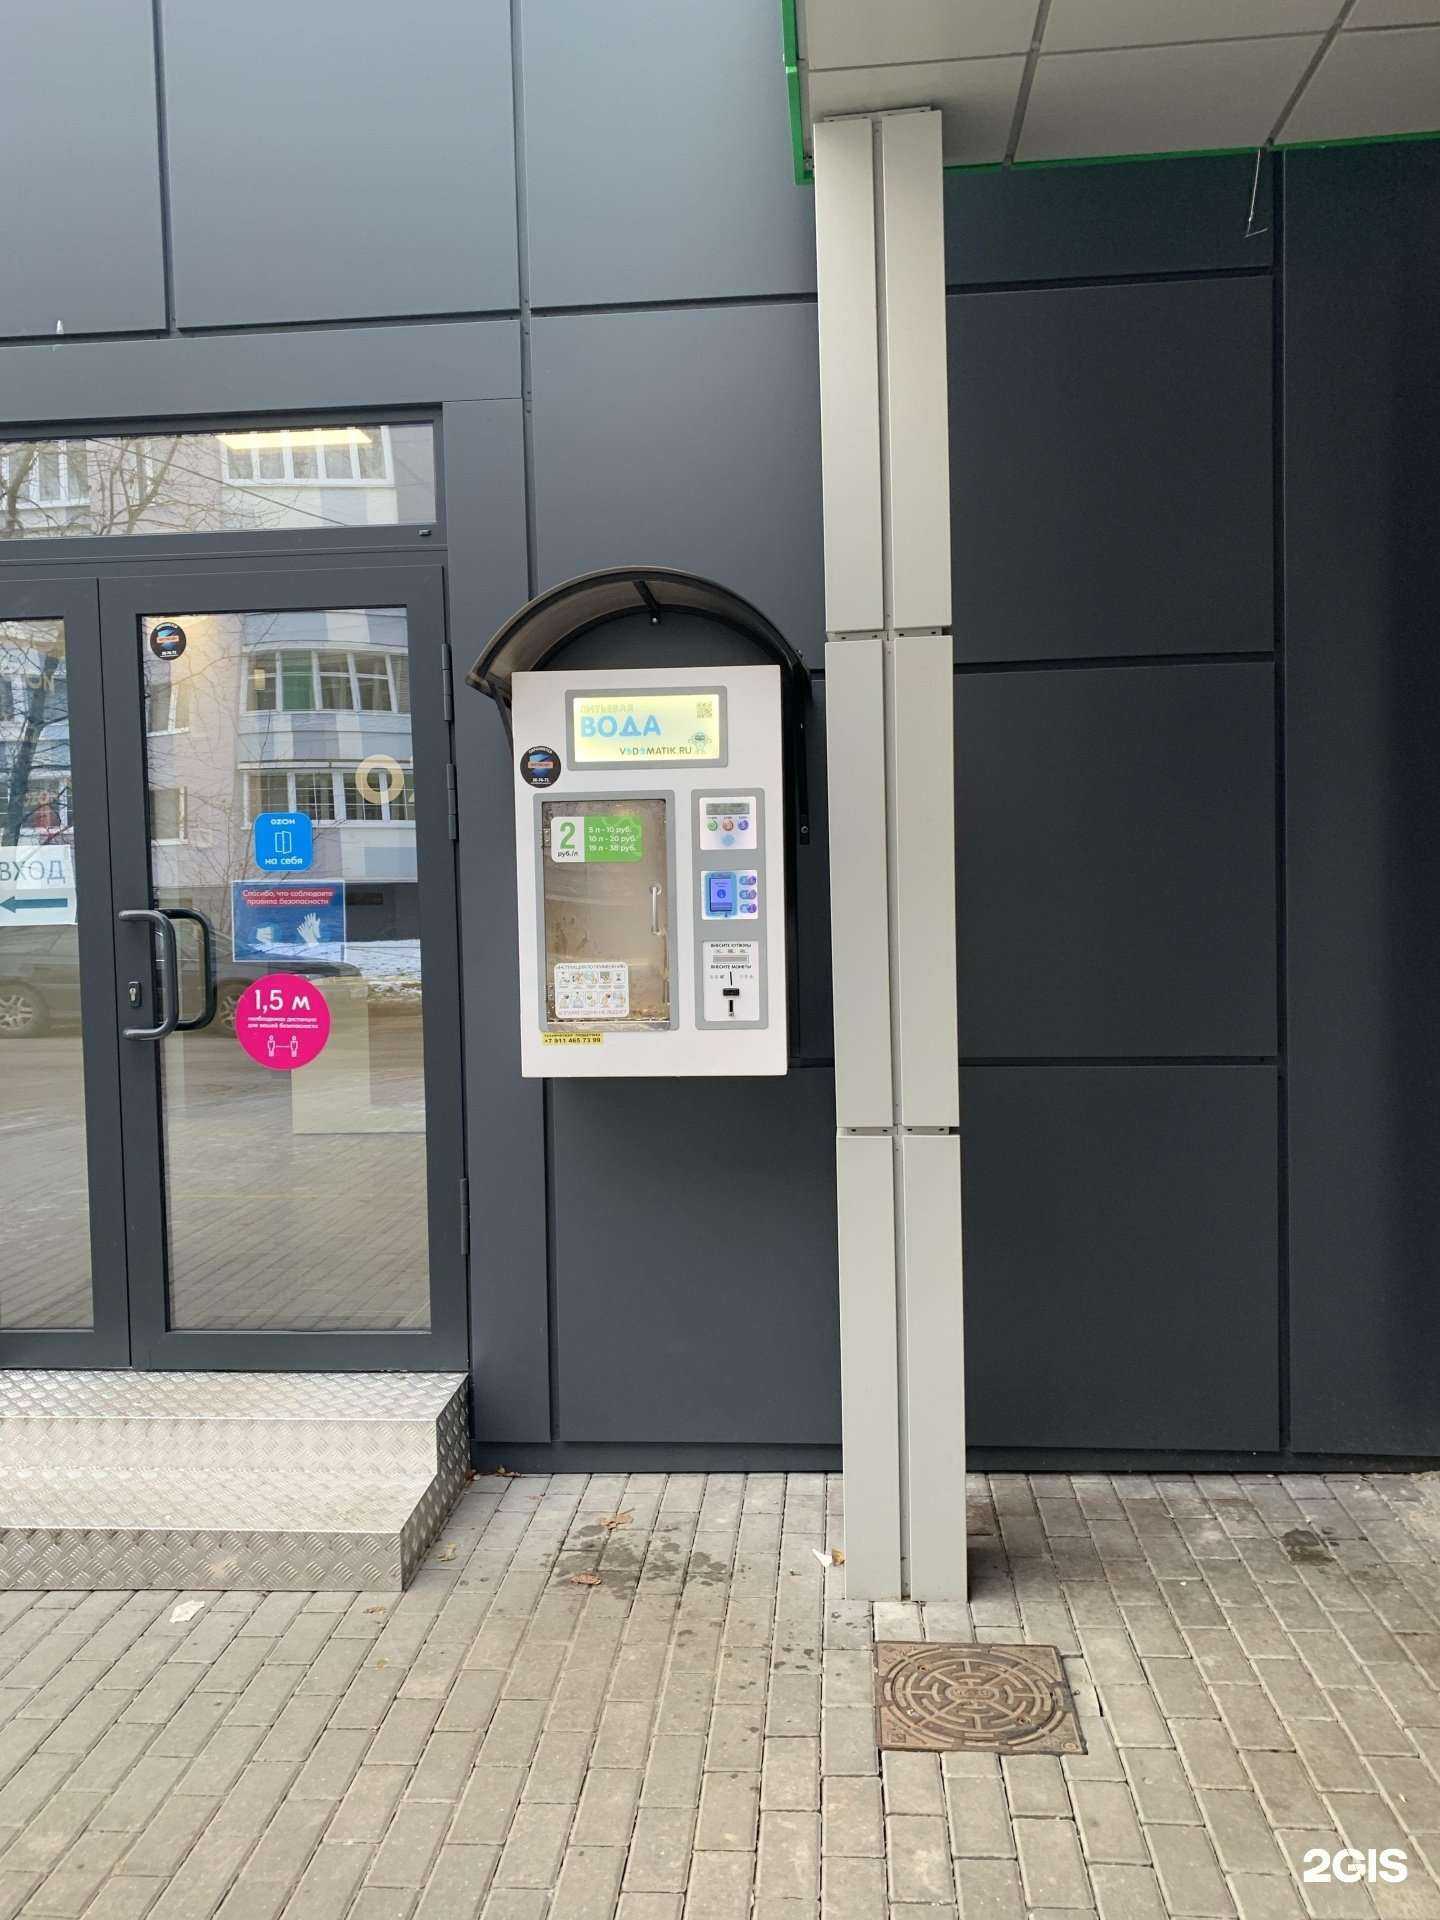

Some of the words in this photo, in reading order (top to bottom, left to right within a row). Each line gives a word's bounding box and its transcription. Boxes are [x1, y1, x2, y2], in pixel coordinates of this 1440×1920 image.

[581, 715, 662, 737] ВОДА
[606, 825, 615, 833] 10
[560, 822, 576, 849] 2
[588, 835, 597, 843] 10
[609, 835, 619, 843] 20
[264, 857, 278, 866] на
[279, 855, 304, 866] себя
[0, 860, 66, 885] ВХОД
[242, 889, 275, 898] Спасибо,
[290, 889, 334, 899] соблюдаете
[246, 899, 277, 907] правила
[279, 897, 329, 905] безопасности
[254, 989, 284, 1014] 1,5
[291, 995, 312, 1011] м
